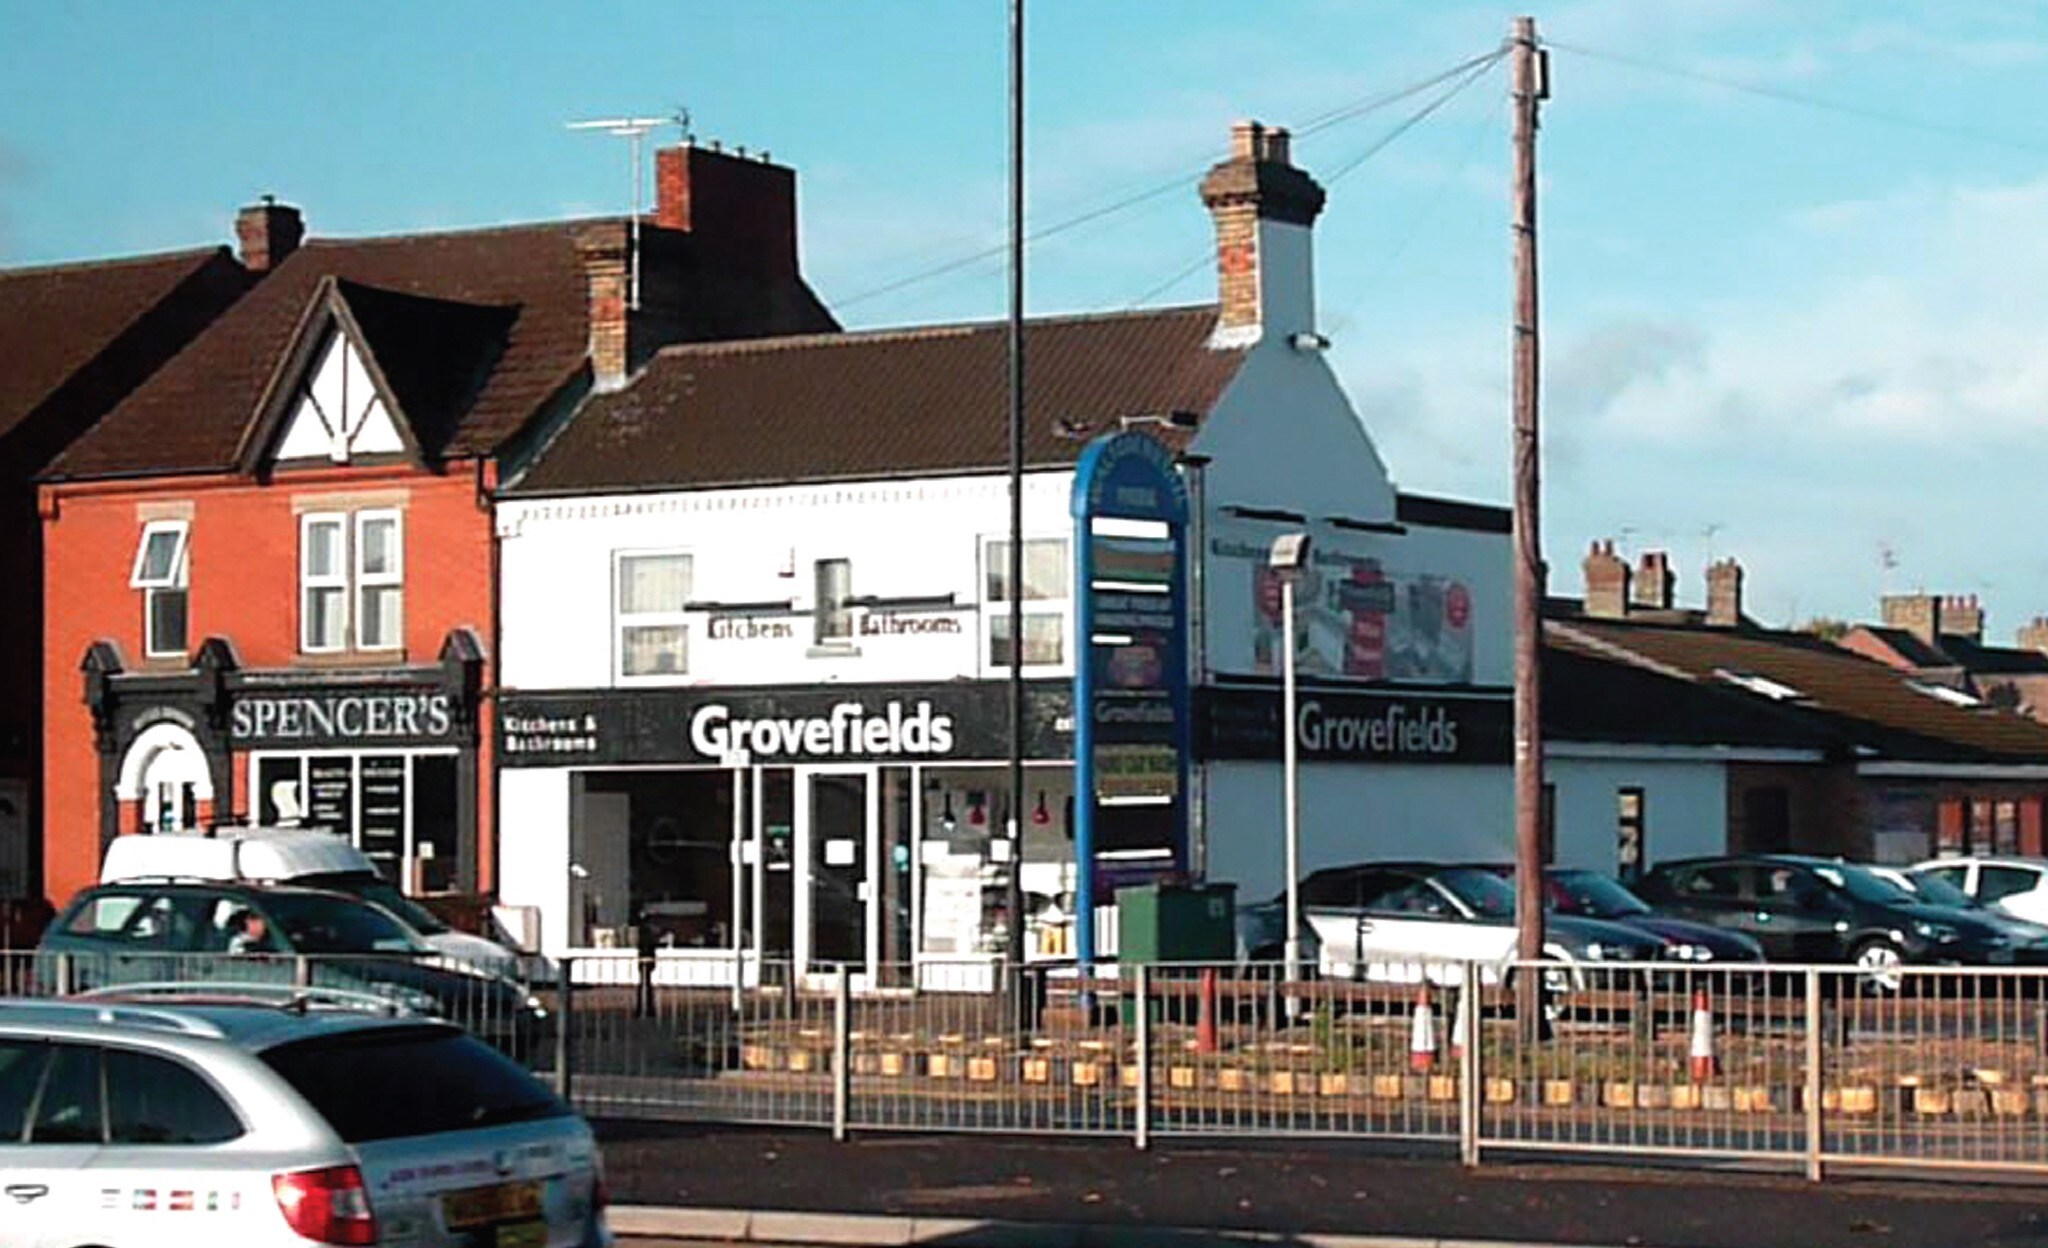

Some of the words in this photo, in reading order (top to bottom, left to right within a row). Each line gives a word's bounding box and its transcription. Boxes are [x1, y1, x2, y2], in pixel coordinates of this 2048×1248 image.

[707, 615, 794, 639] Kitchens
[860, 611, 962, 635] Bathrooms
[232, 695, 450, 738] SPENCER'S
[691, 701, 953, 756] Grovefields
[1299, 701, 1458, 753] Grovefields
